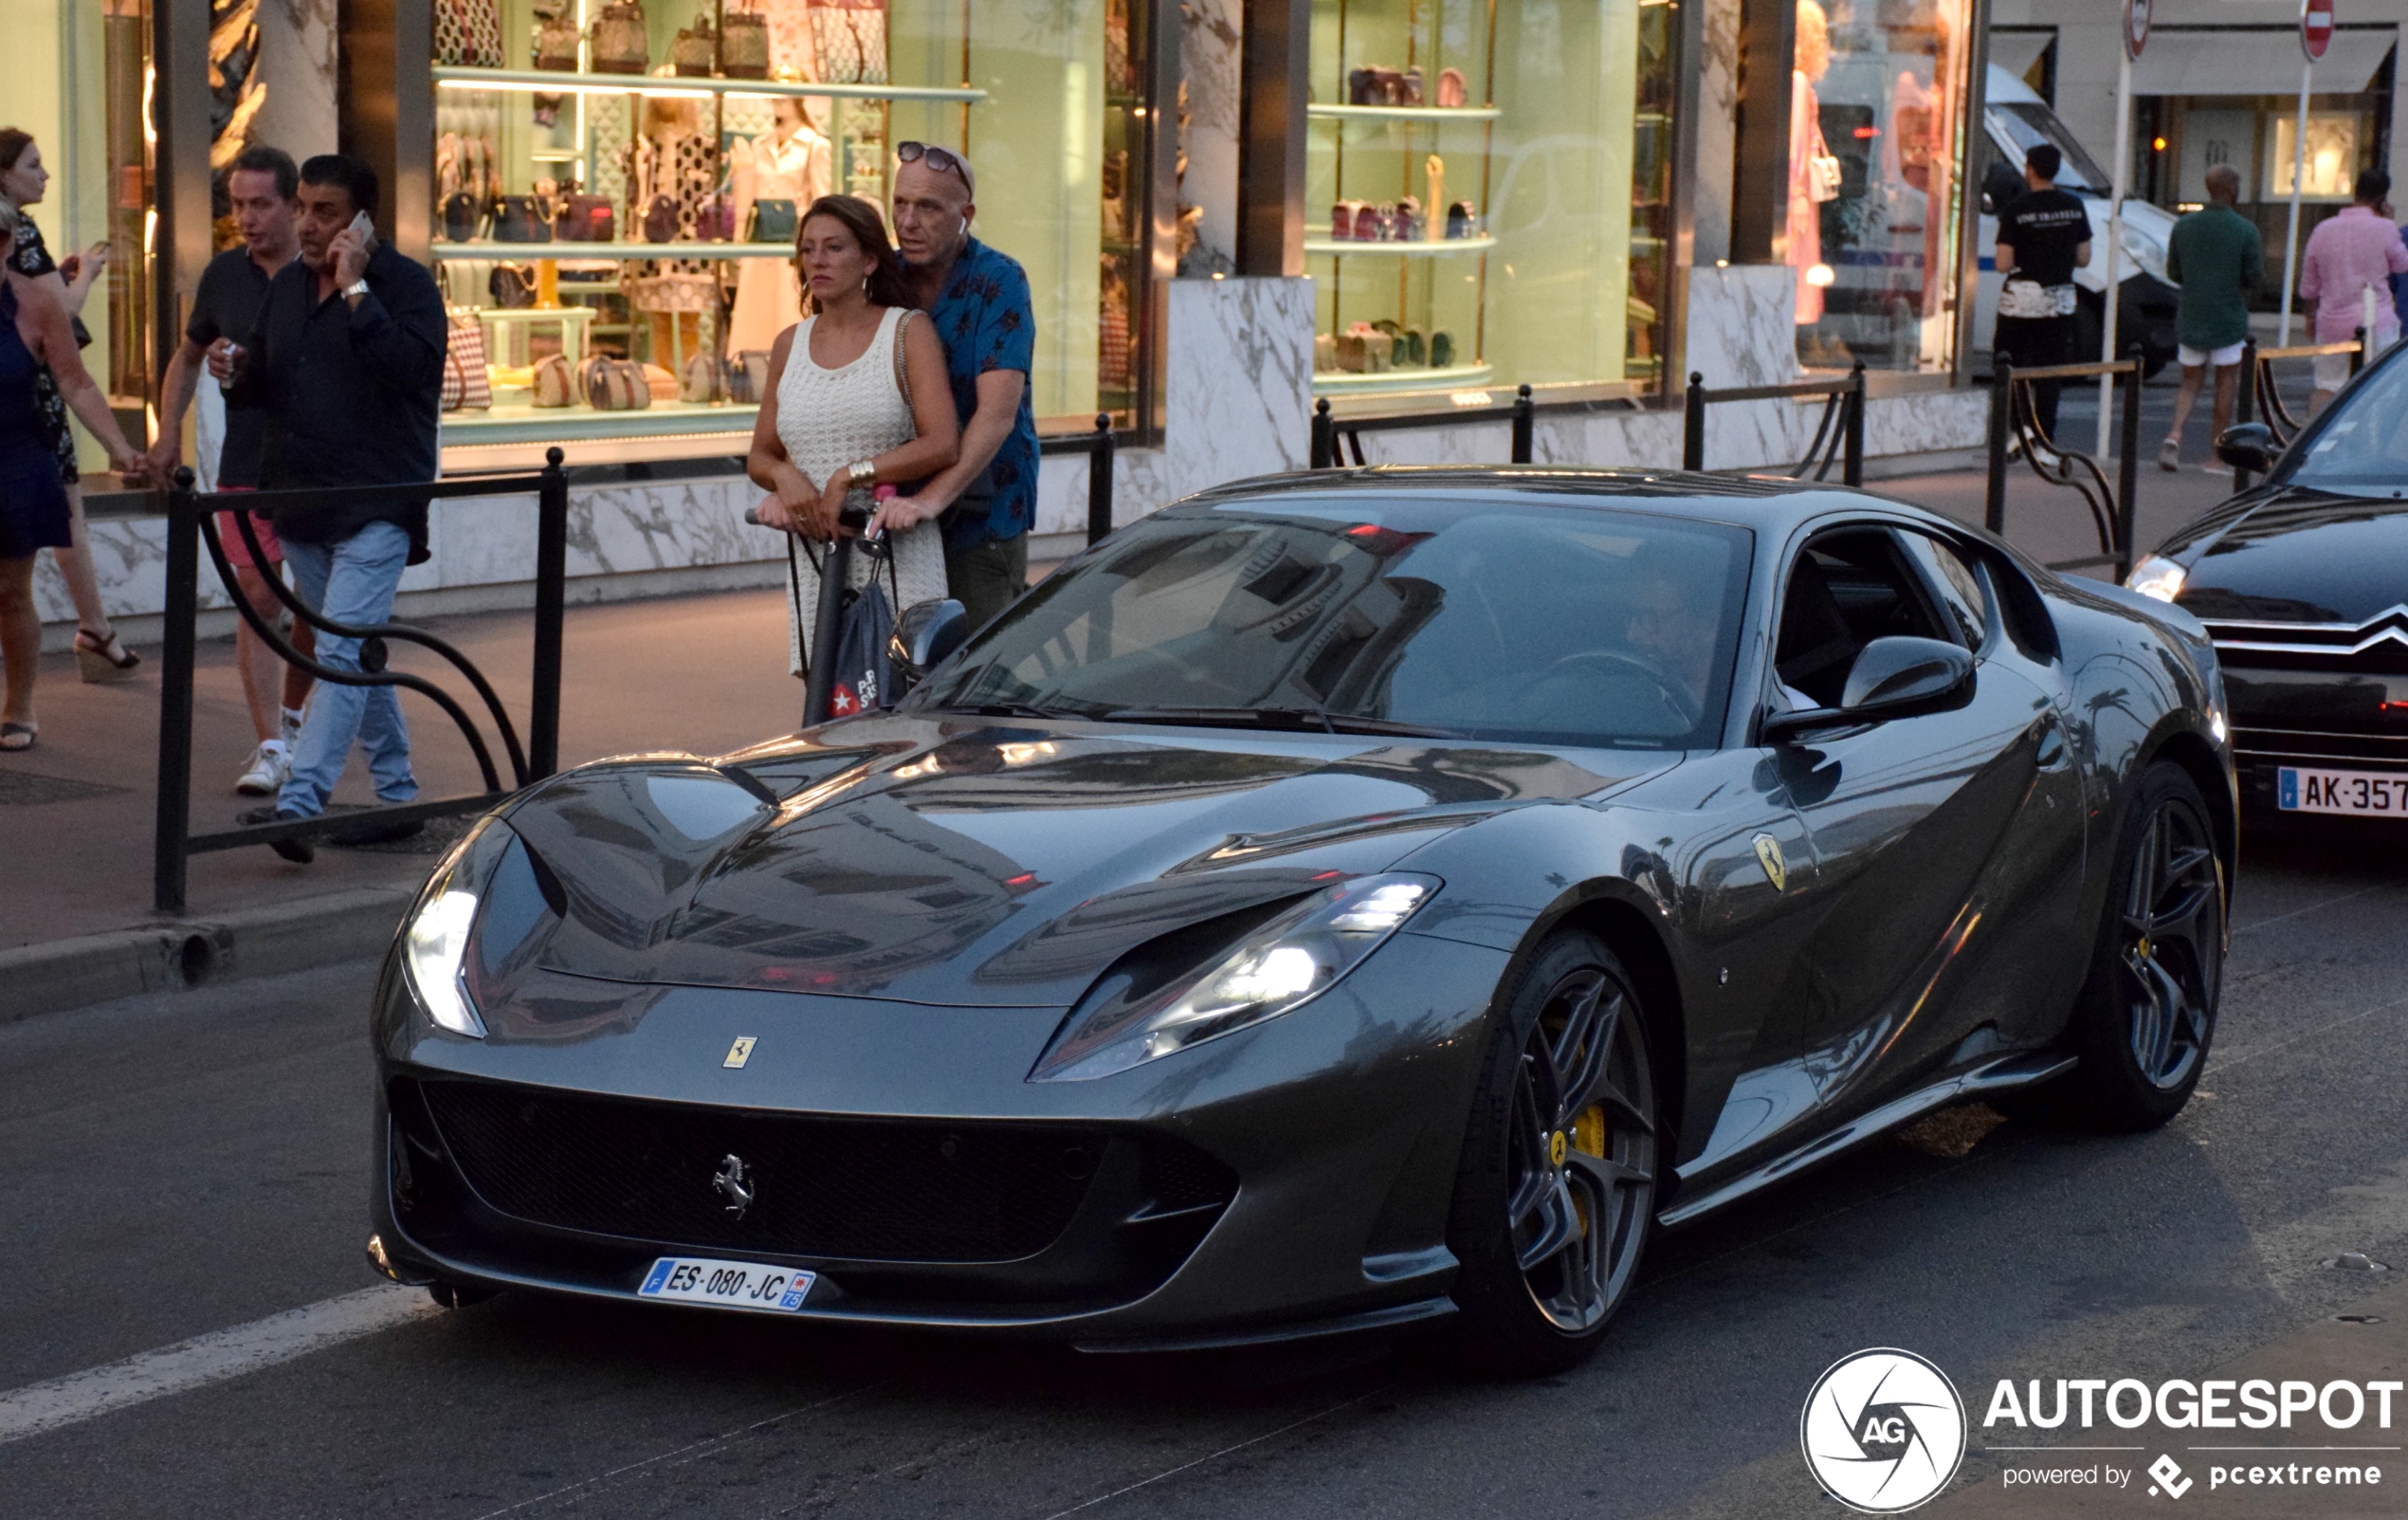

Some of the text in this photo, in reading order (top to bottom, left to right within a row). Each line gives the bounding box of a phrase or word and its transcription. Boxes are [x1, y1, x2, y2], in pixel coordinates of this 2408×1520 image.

[2306, 776, 2408, 811] AK-357
[648, 1278, 661, 1289] F
[666, 1265, 785, 1301] ES-080-JC
[783, 1292, 801, 1306] 75
